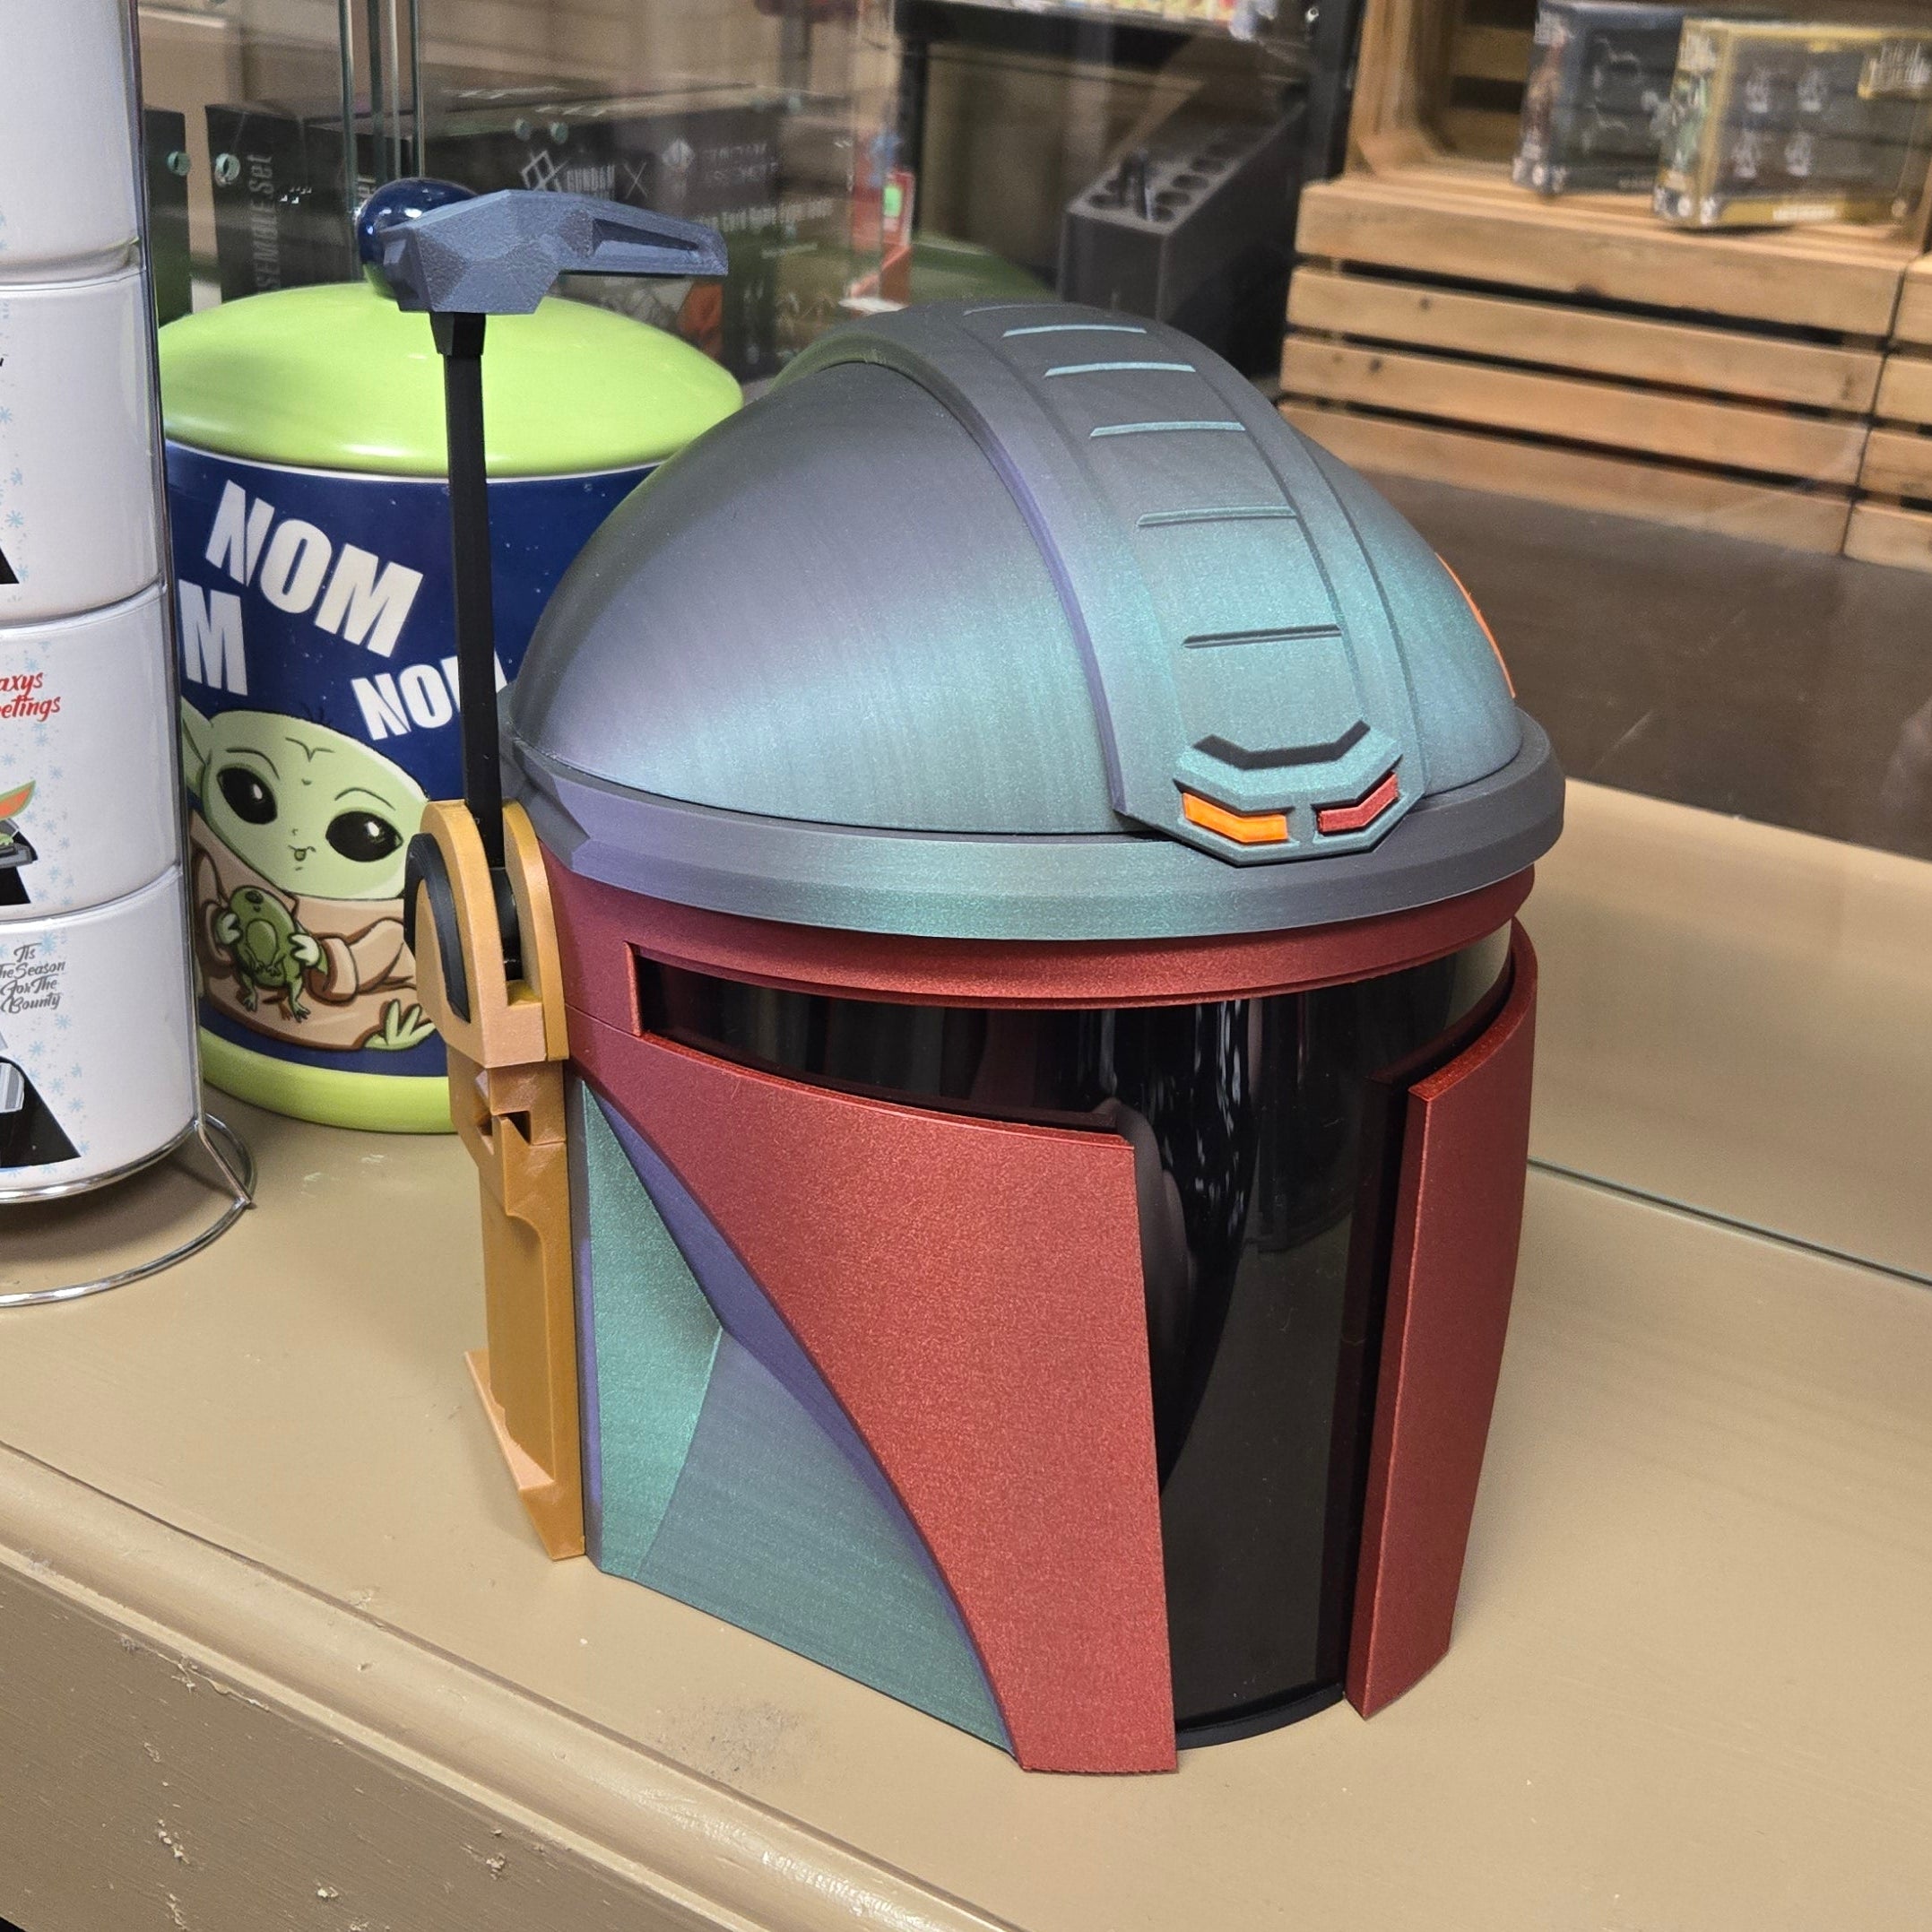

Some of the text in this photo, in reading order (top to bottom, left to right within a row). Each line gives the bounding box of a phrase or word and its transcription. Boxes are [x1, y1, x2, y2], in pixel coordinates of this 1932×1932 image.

[205, 480, 423, 657] NOM
[178, 579, 247, 696] M
[0, 672, 43, 697] axys
[0, 695, 61, 723] etings
[13, 942, 42, 963] Tis
[13, 961, 66, 980] Season
[30, 973, 59, 993] The
[0, 992, 63, 1014] Bounty
